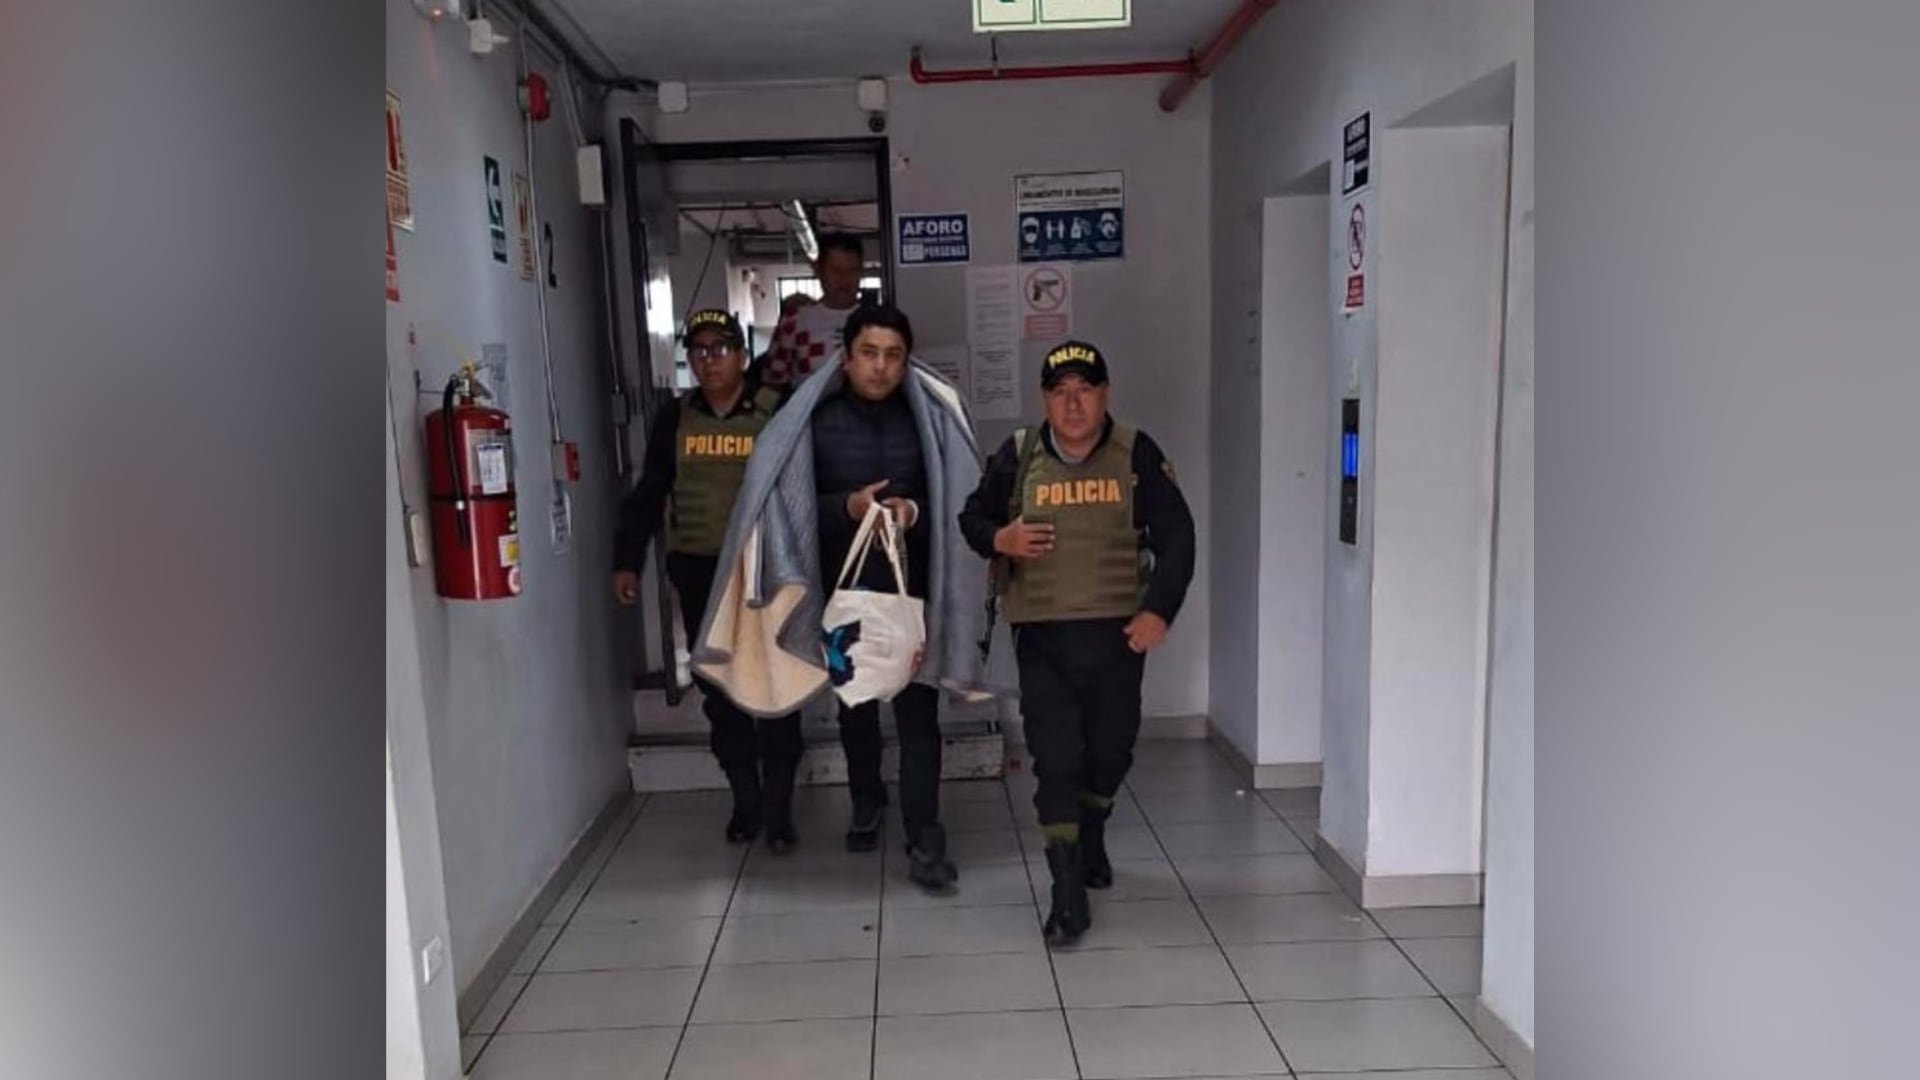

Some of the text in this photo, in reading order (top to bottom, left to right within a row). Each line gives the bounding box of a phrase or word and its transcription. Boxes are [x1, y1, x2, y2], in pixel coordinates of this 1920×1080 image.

[903, 219, 963, 236] AFORO
[1048, 346, 1096, 369] POLICIA
[1036, 478, 1121, 507] POLICIA
